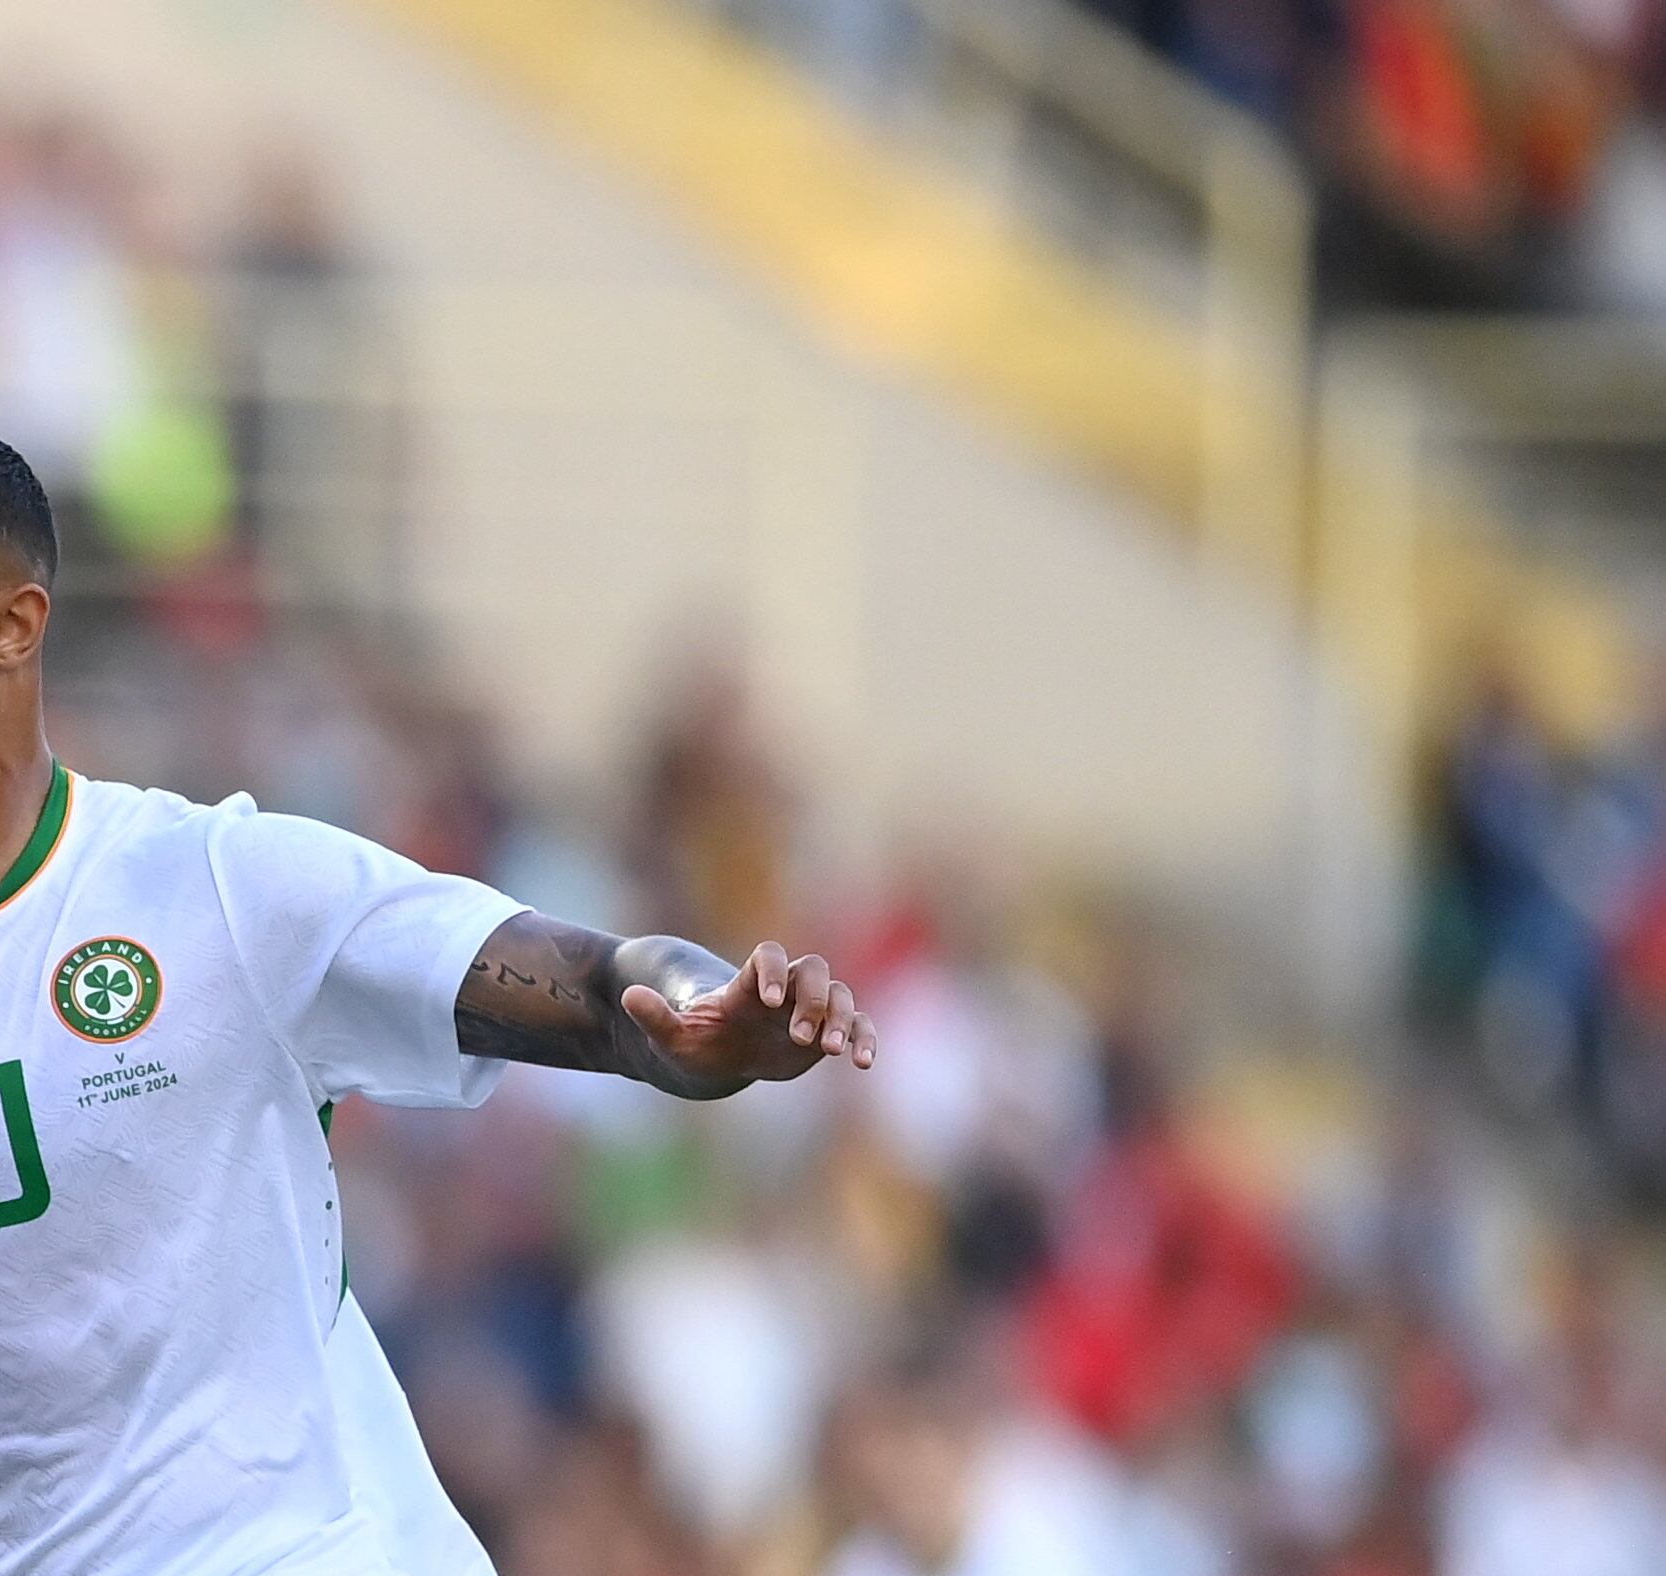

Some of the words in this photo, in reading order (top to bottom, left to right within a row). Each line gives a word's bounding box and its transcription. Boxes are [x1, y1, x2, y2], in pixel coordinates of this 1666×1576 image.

[57, 941, 143, 985] IRELAND
[83, 1008, 148, 1036] FOOTBALL
[81, 1060, 167, 1090] PORTUGAL
[101, 1082, 142, 1104] JUNE
[144, 1072, 178, 1093] 2024
